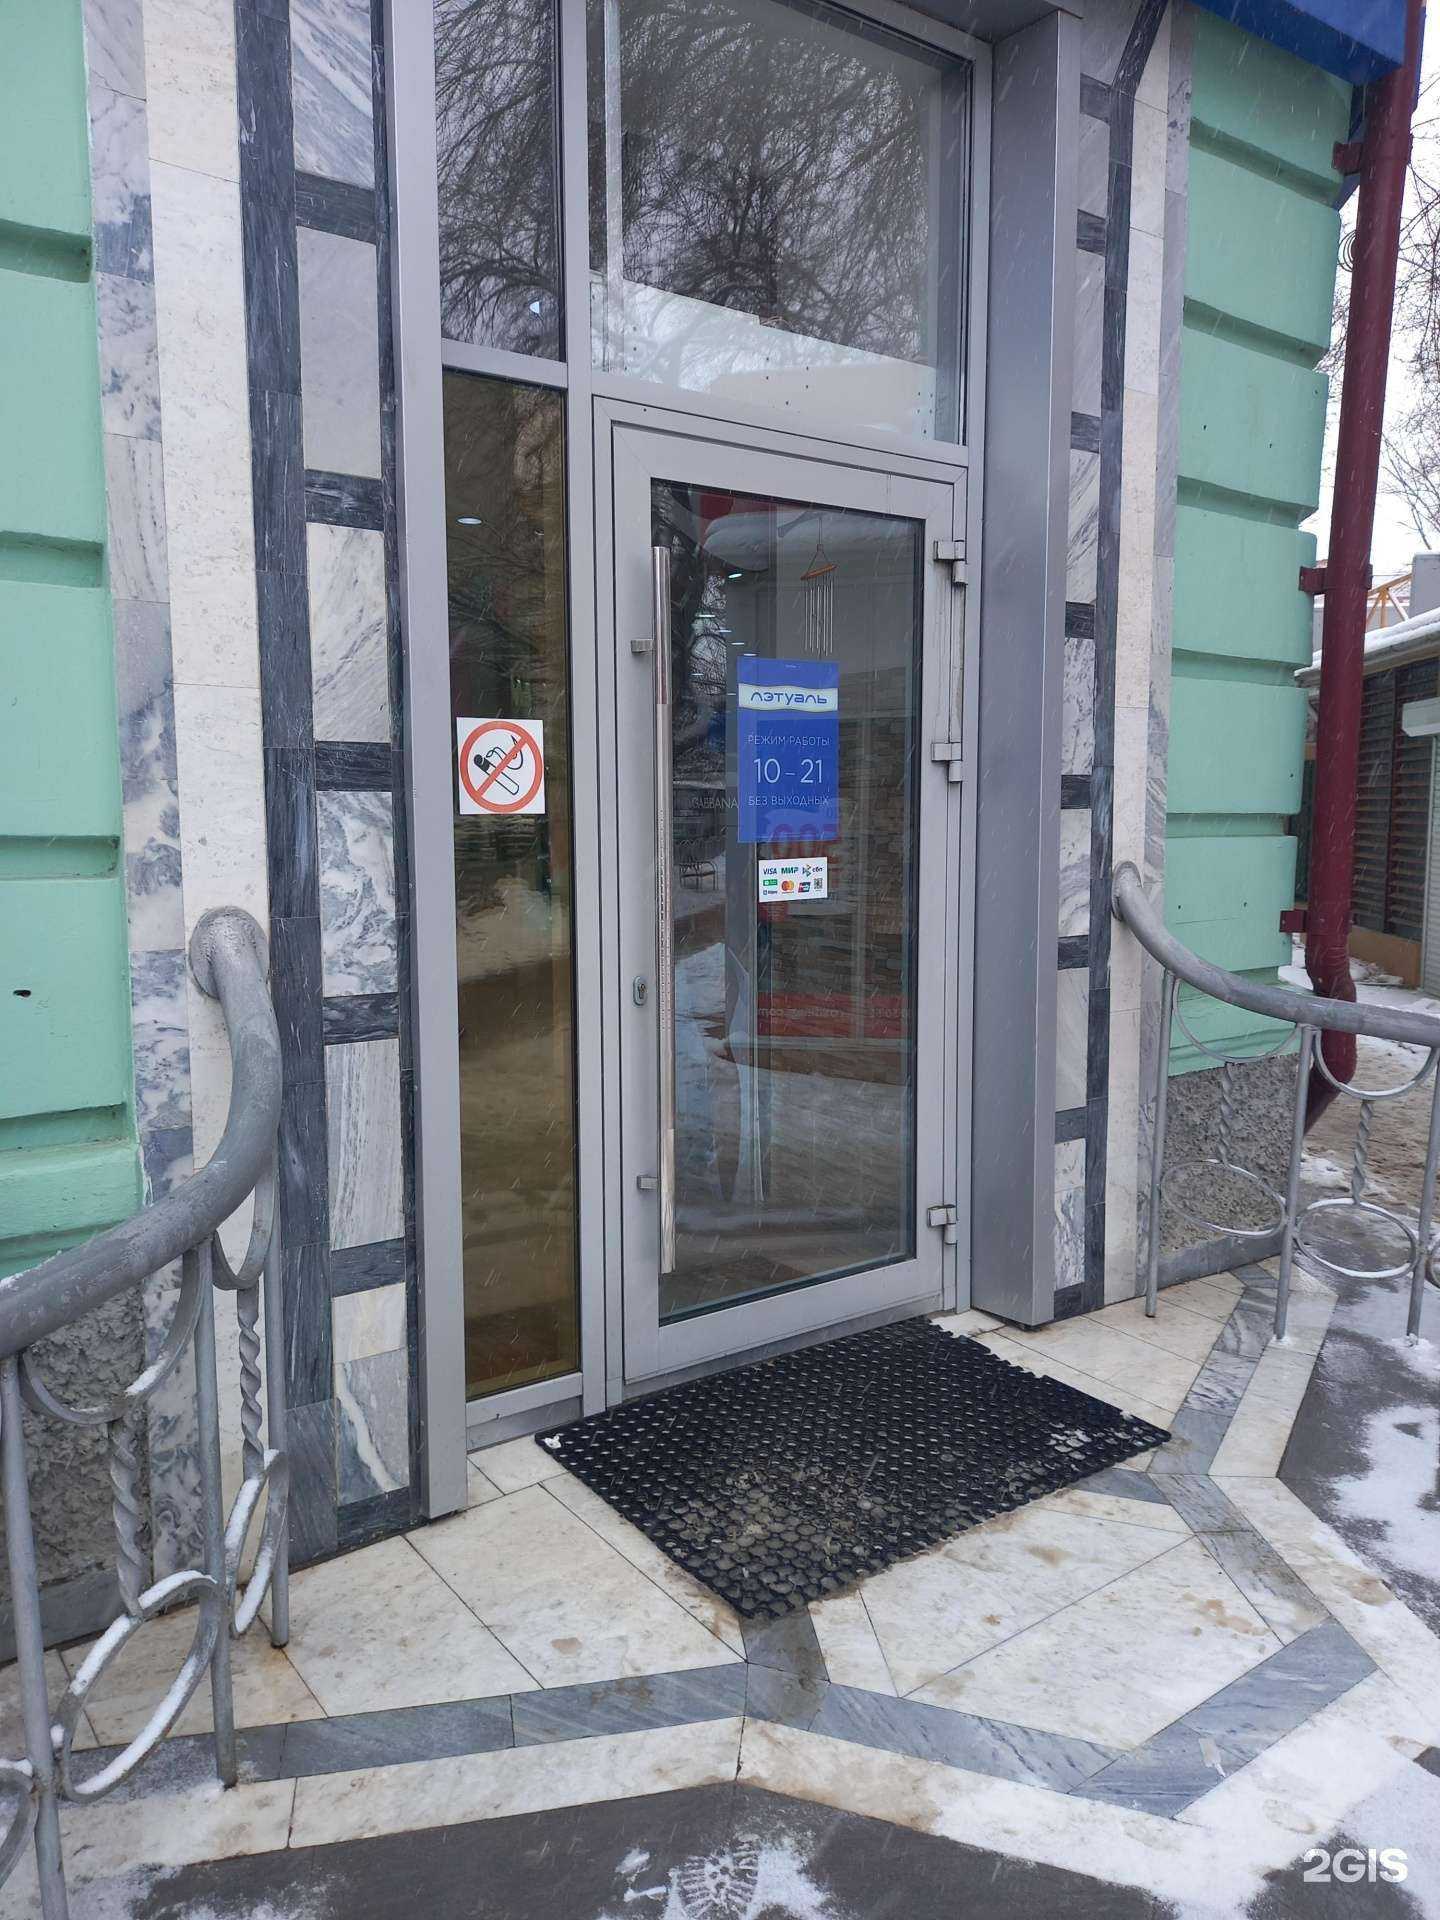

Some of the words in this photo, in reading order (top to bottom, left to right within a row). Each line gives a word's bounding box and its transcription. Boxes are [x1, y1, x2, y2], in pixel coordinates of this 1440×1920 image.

[748, 735, 785, 746] РЕЖИМ
[789, 736, 830, 748] РАБОТЫ
[748, 795, 768, 806] БЕЗ
[771, 795, 829, 808] ВЫХОДНЫХ
[763, 867, 777, 875] VISA
[781, 866, 798, 875] МИР
